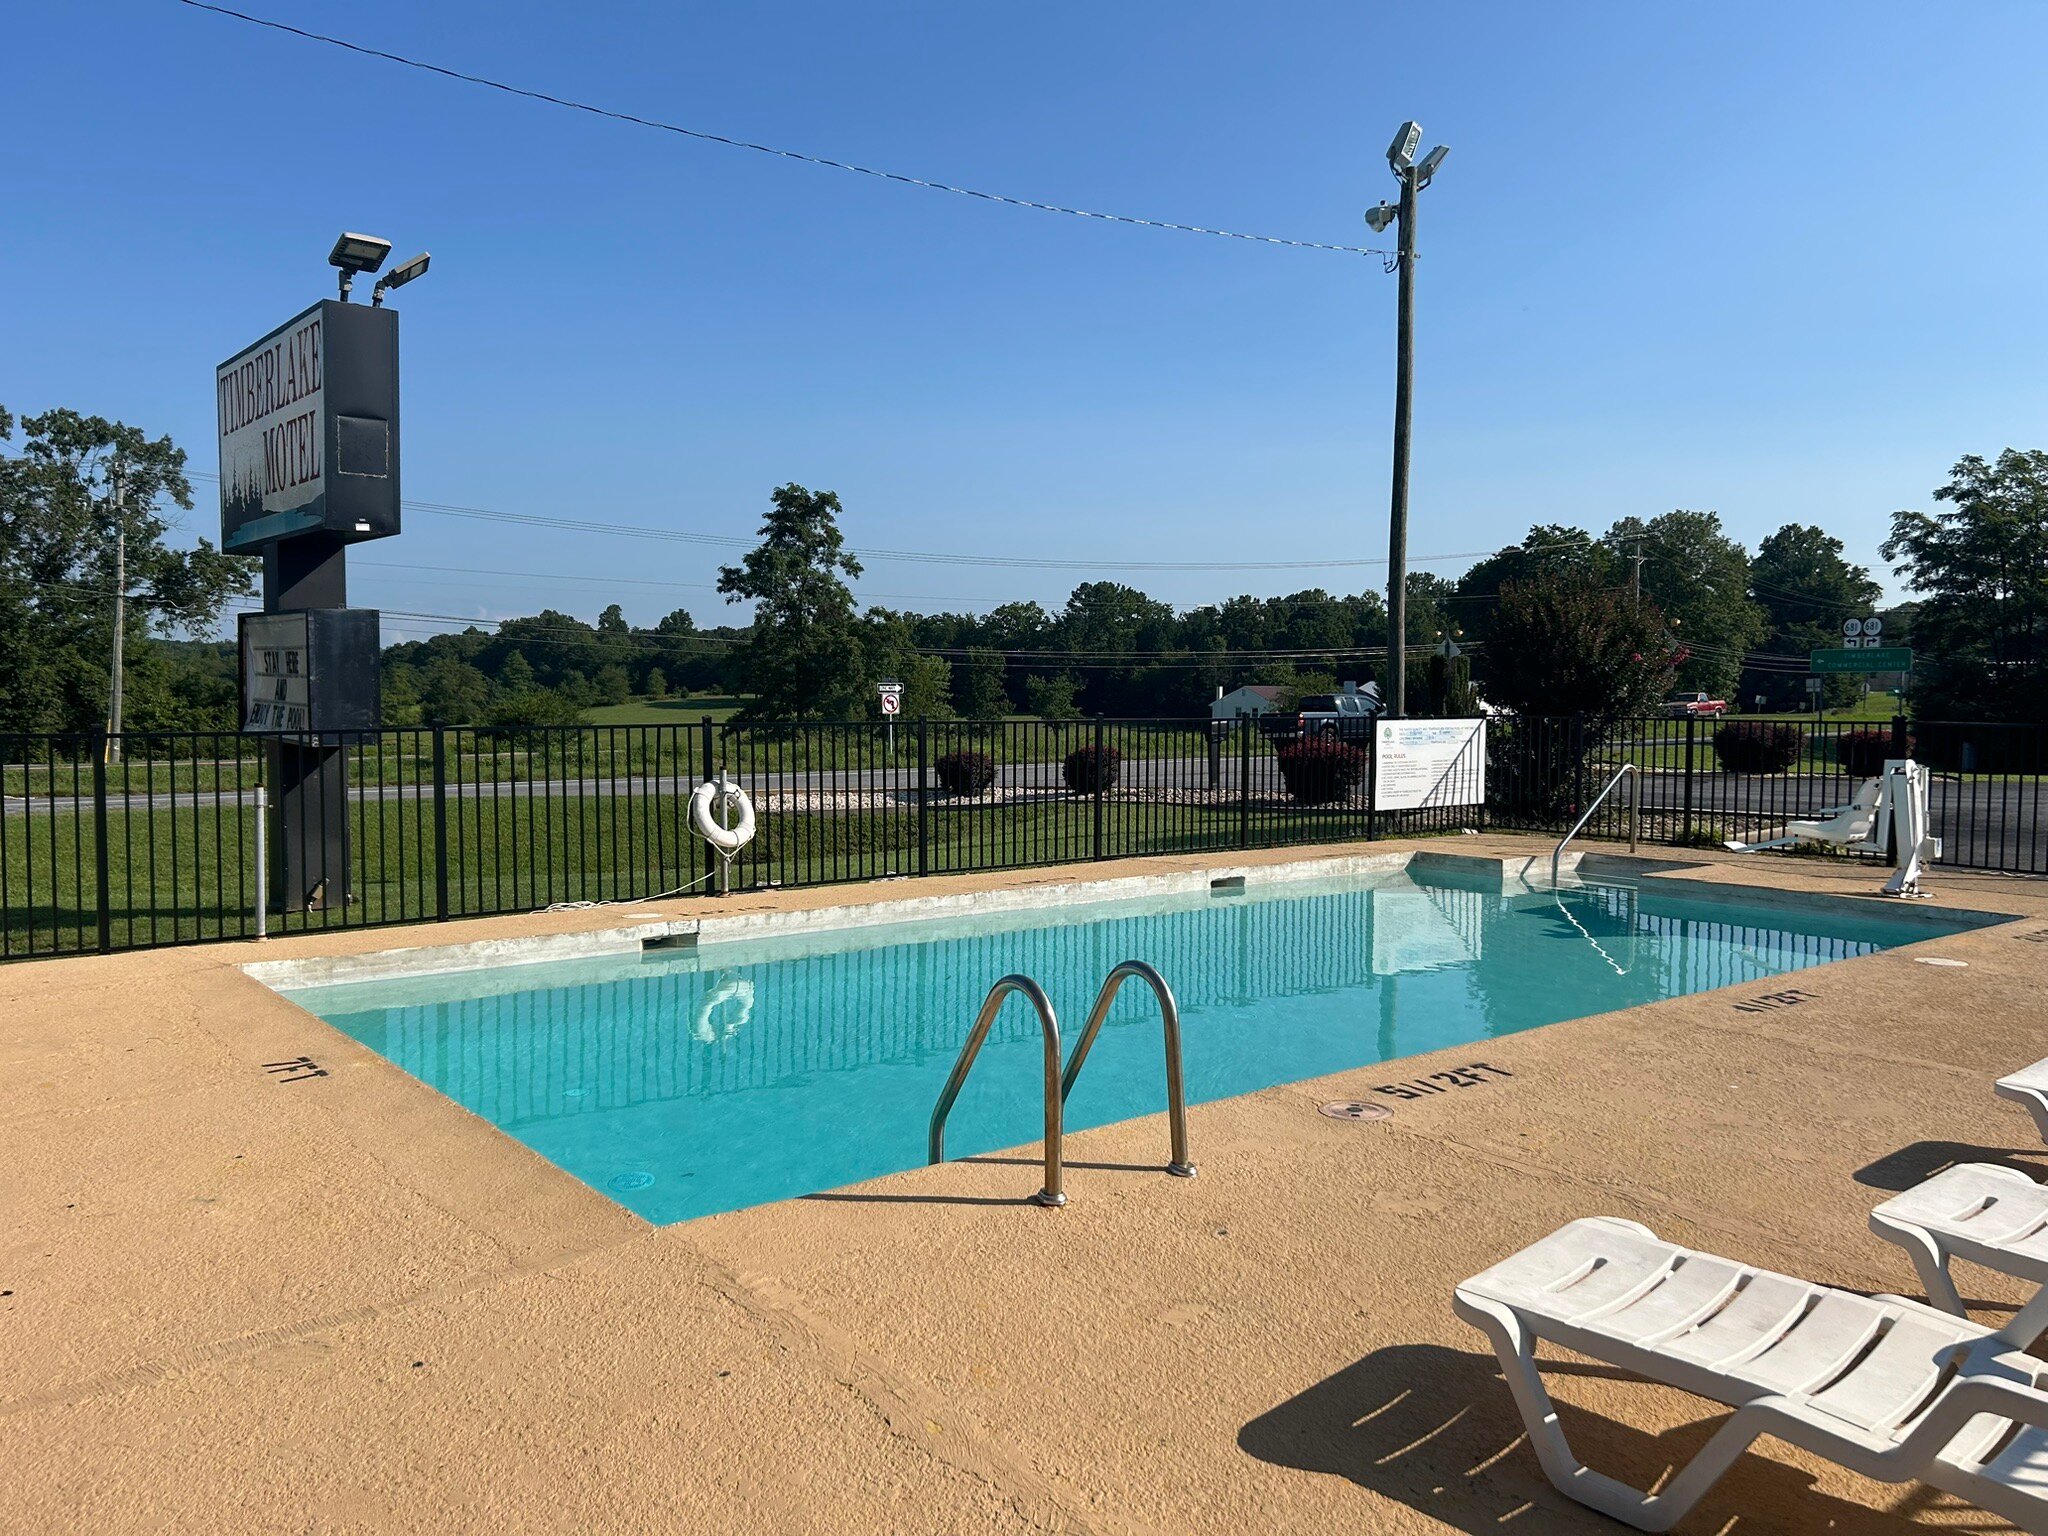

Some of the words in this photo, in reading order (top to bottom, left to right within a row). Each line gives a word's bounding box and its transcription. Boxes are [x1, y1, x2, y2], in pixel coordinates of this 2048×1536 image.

[220, 319, 322, 436] TIMBERLAKE
[262, 409, 321, 496] MOTEL
[1845, 623, 1857, 631] 681
[1865, 622, 1878, 630] 681
[263, 651, 280, 673] STAY
[285, 651, 299, 674] HERE
[275, 678, 288, 701] AND
[272, 705, 285, 728] THE
